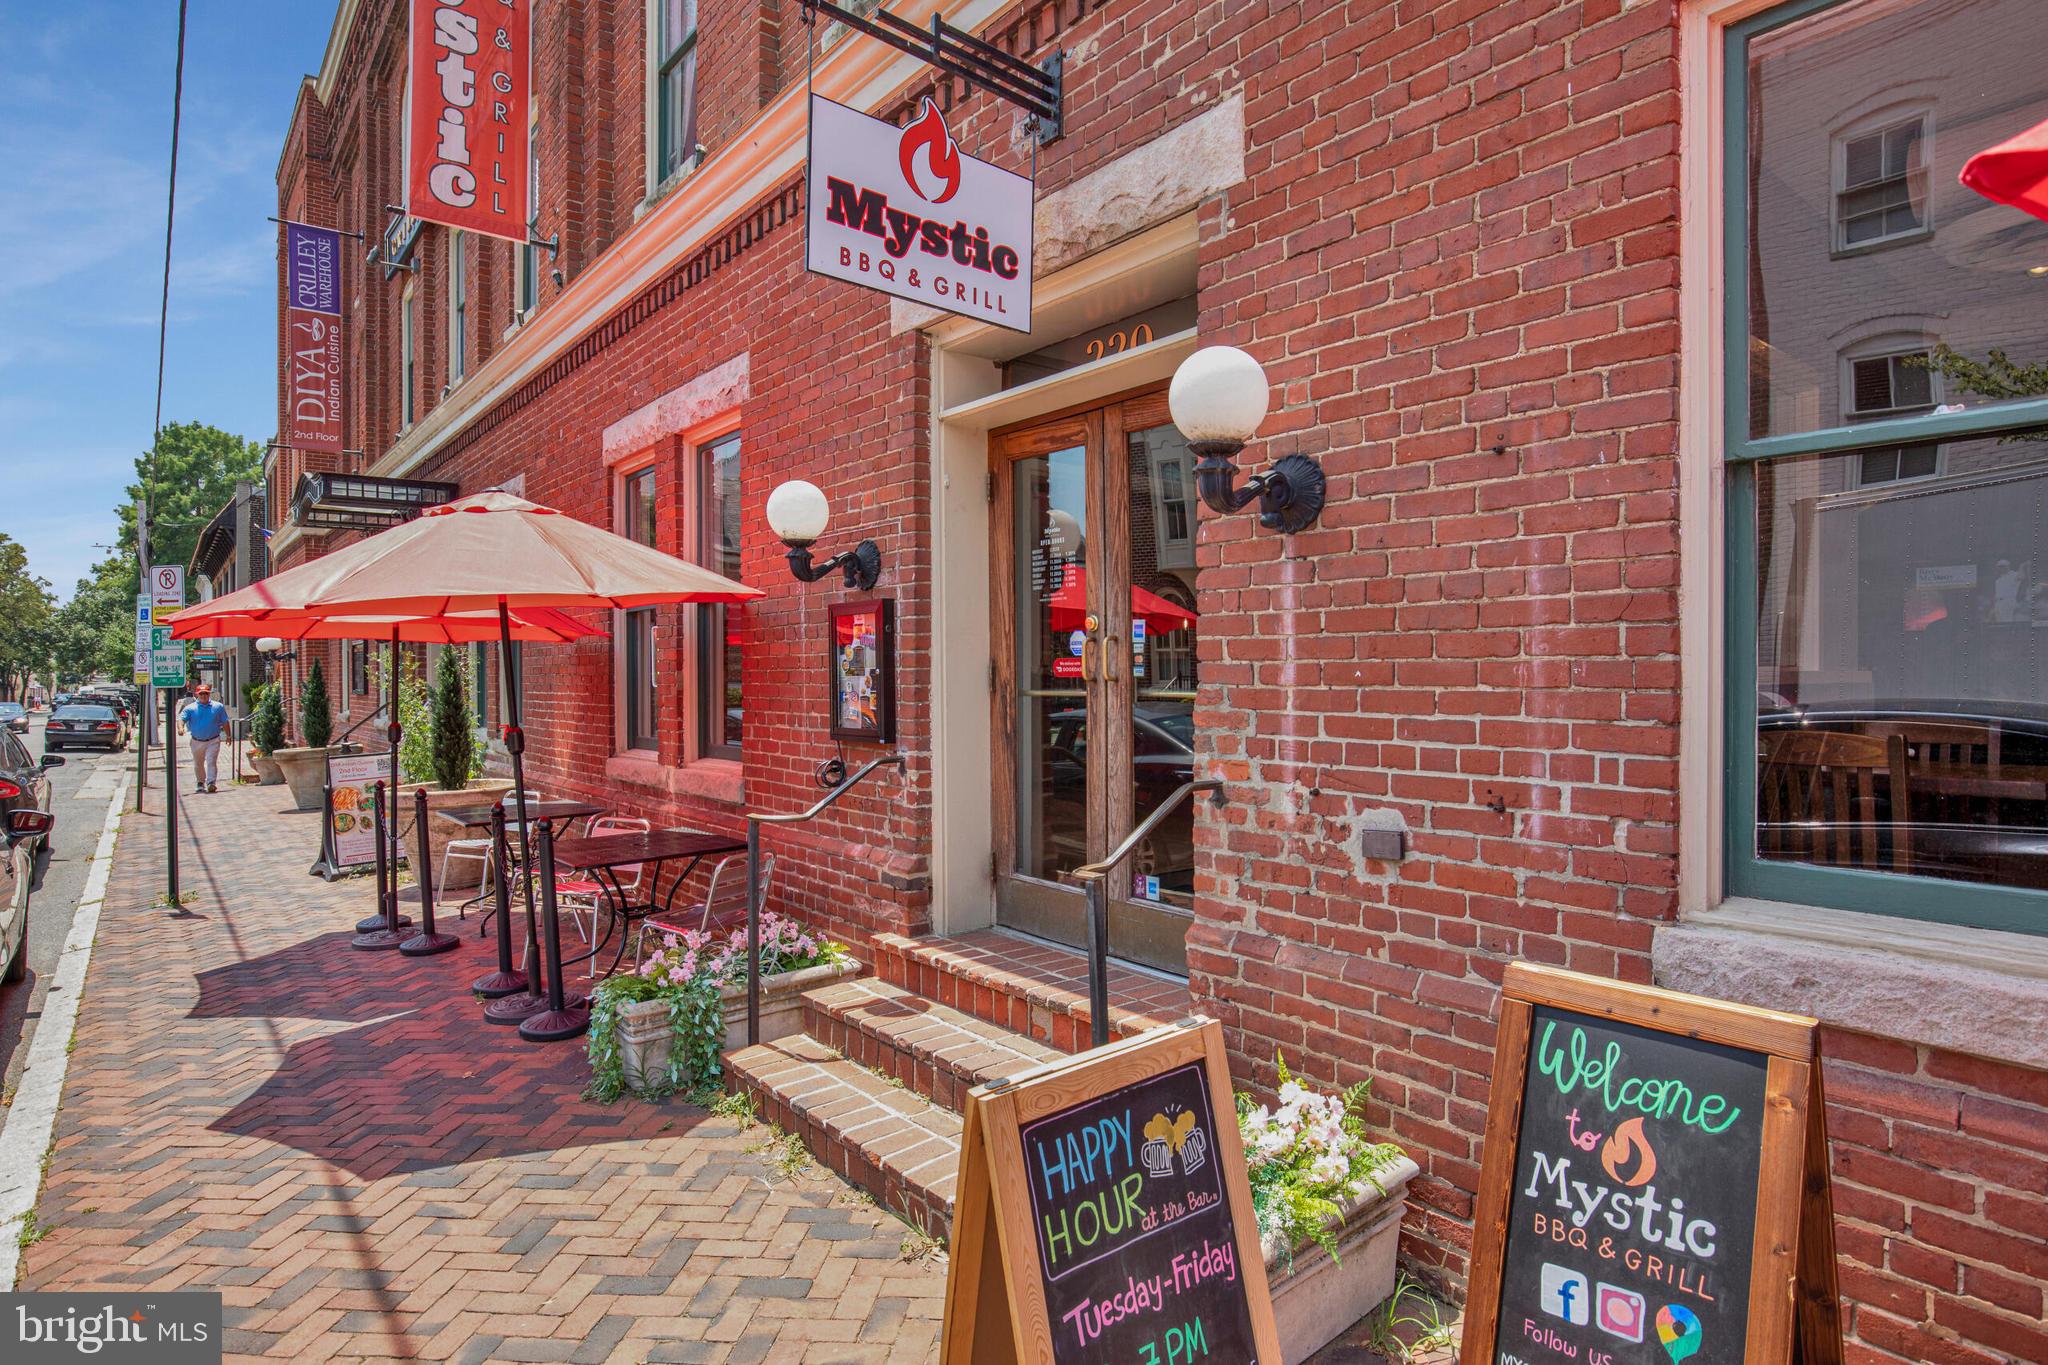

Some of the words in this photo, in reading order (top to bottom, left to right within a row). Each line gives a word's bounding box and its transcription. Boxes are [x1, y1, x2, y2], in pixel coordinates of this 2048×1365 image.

[494, 28, 513, 51] &
[429, 0, 479, 208] stic
[492, 71, 513, 215] GRILL
[826, 175, 1019, 280] Mystic
[297, 233, 317, 307] CRILLEY
[318, 238, 332, 308] WAREHOUSE
[839, 246, 896, 283] BBQ
[908, 267, 921, 288] &
[933, 276, 1006, 314] GRILL
[296, 346, 326, 425] DIYA
[327, 325, 340, 374] Cuisine
[294, 430, 313, 440] 2nd
[315, 432, 339, 442] Floor
[328, 379, 340, 421] Indian
[154, 633, 161, 646] 3
[1538, 1020, 1742, 1134] Welcome
[1037, 1108, 1134, 1201] HAPPY
[1565, 1107, 1602, 1151] to
[1044, 1172, 1147, 1264] HOUR
[1141, 1210, 1159, 1232] at
[1162, 1201, 1186, 1222] the
[1524, 1150, 1717, 1257] Mystic
[1533, 1213, 1588, 1250] BBQ
[1598, 1236, 1616, 1260] &
[1624, 1248, 1715, 1301] GRILL
[1062, 1240, 1236, 1347] Tuesday-Friday
[1164, 1316, 1208, 1365] PM
[1523, 1318, 1577, 1358] Follow
